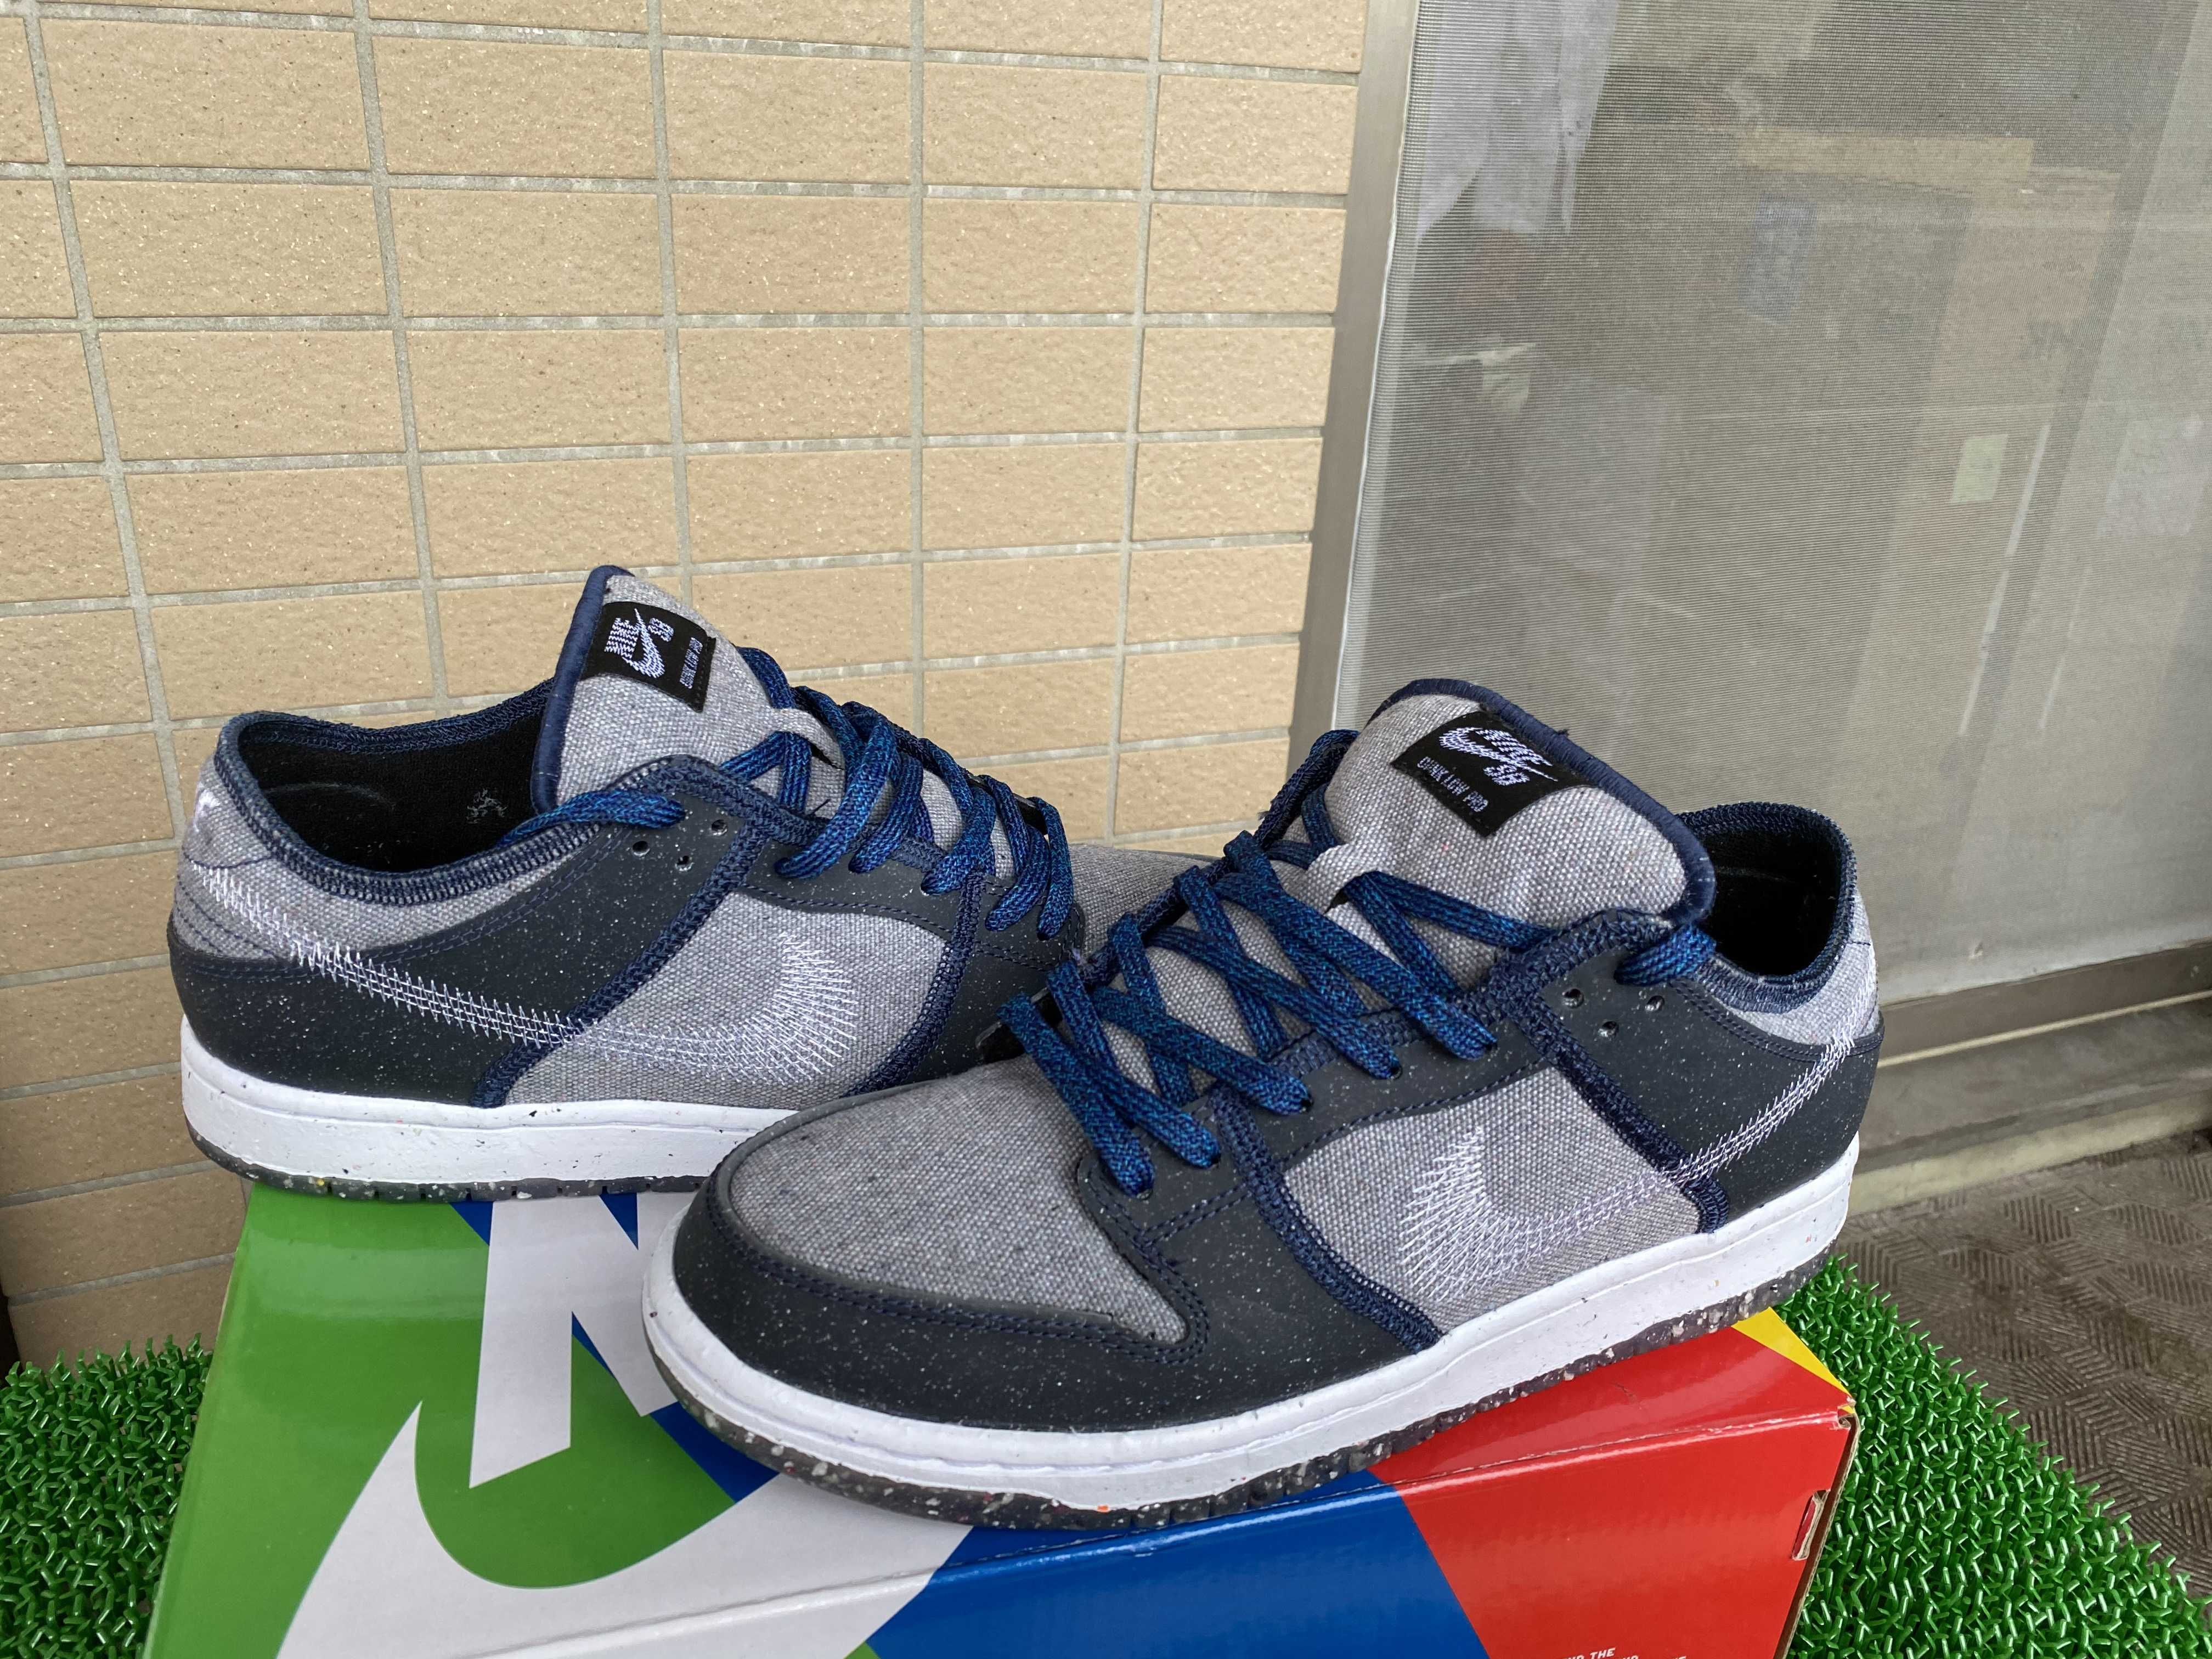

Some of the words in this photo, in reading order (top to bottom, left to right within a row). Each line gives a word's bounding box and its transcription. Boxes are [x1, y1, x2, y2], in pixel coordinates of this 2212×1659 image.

[604, 617, 640, 659] NIKE
[648, 618, 674, 642] SB
[1475, 729, 1553, 766] NIKE
[1483, 764, 1530, 786] SB
[1590, 1647, 1616, 1659] THE
